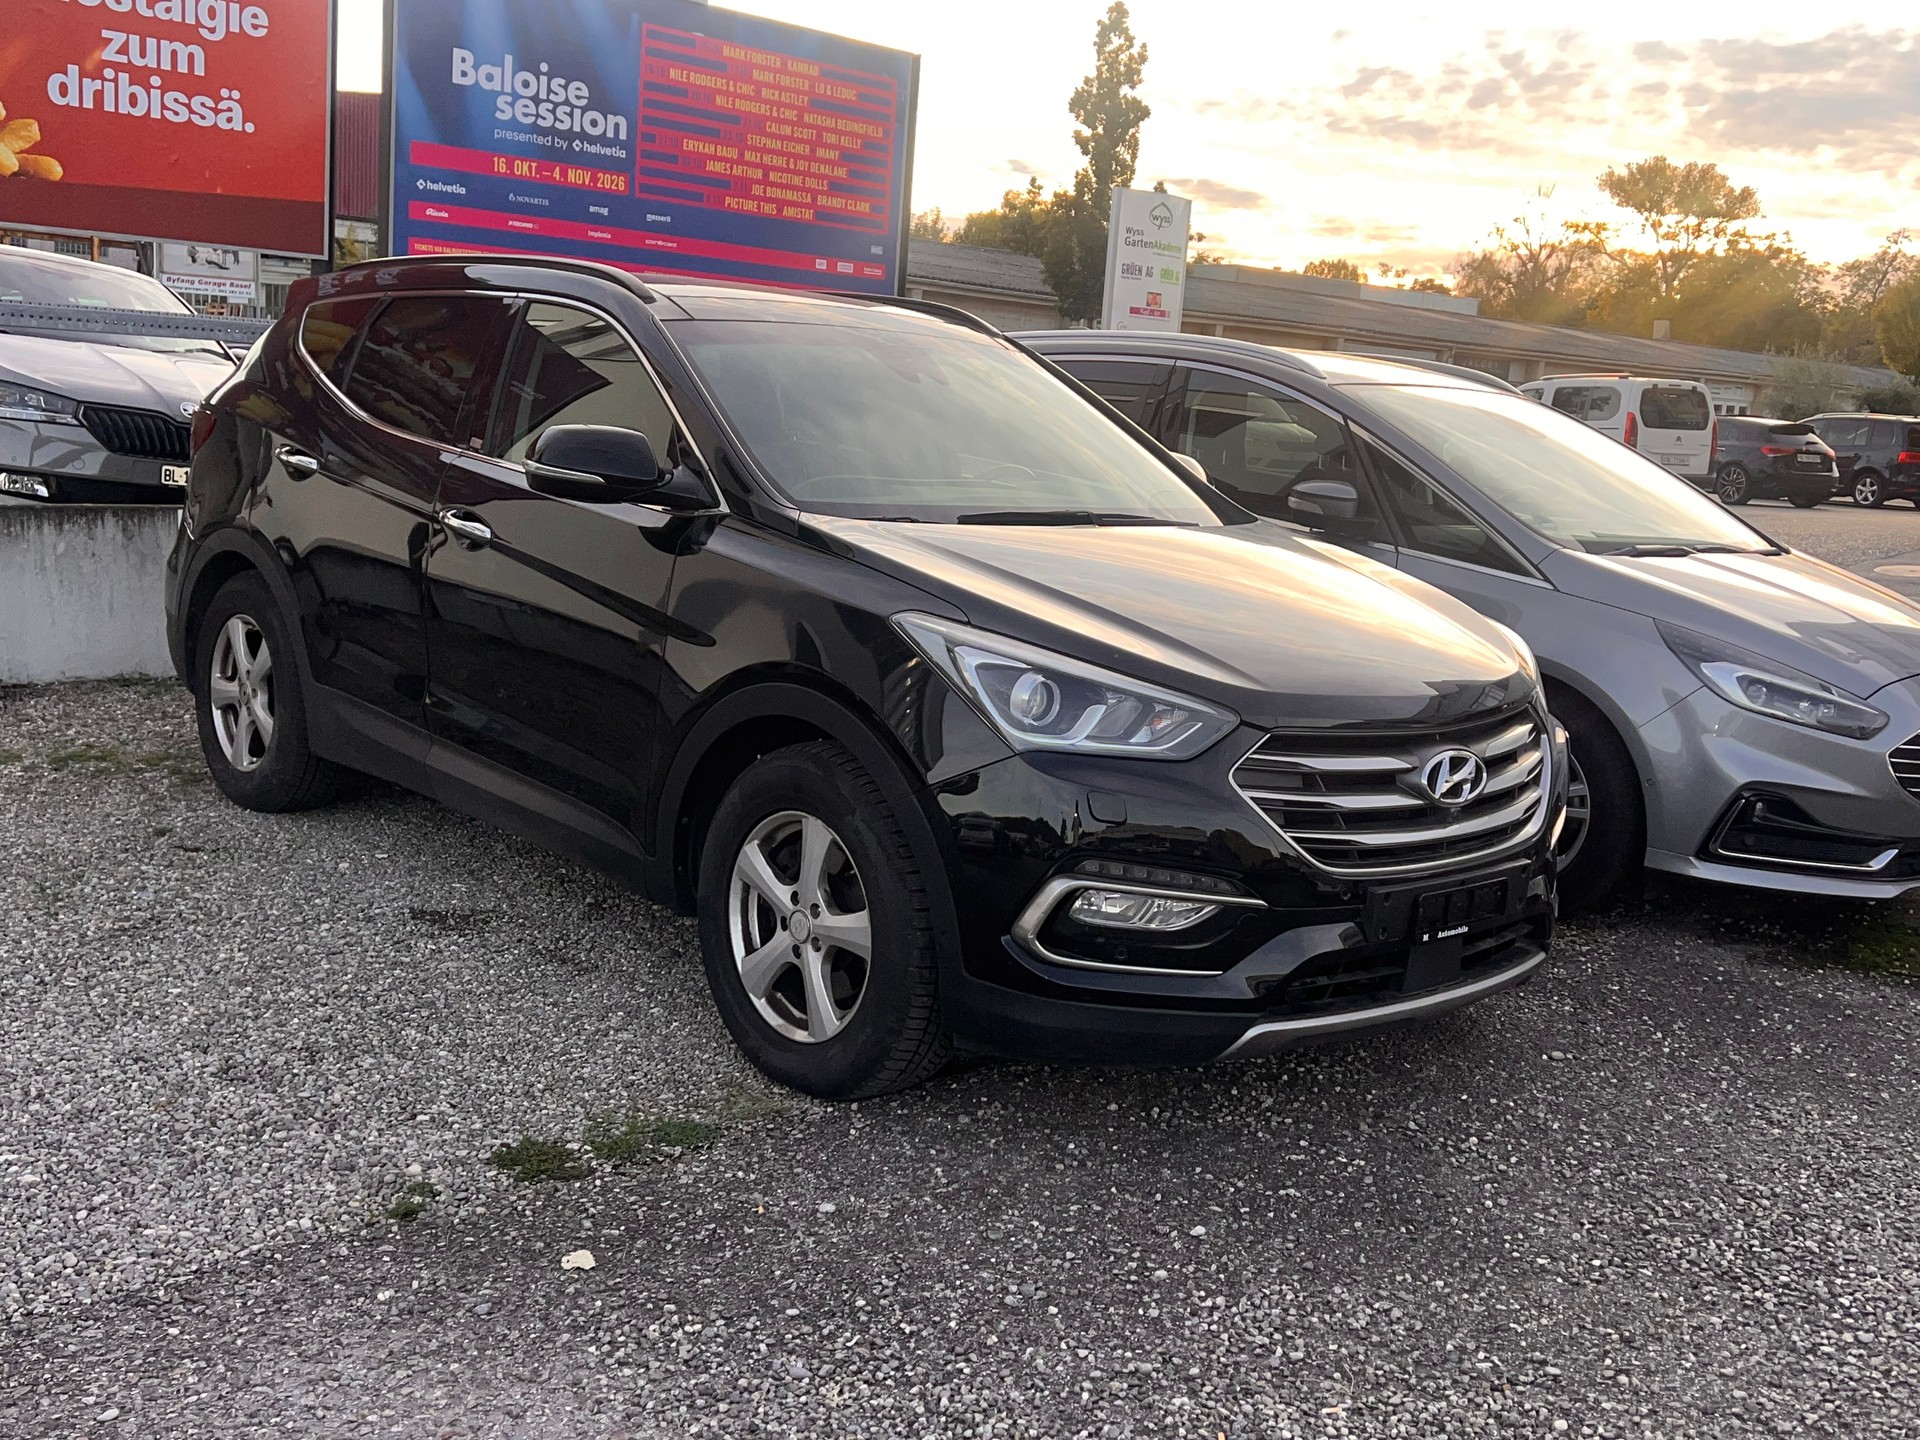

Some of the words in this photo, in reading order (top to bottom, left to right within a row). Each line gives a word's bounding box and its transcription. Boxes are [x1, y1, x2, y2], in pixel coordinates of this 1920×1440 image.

[59, 0, 269, 41] algie
[101, 29, 205, 76] zum
[723, 45, 746, 61] MARK
[747, 50, 781, 68] FORSTER
[787, 59, 819, 77] KAMRAD
[452, 47, 589, 106] Baloise
[669, 67, 688, 82] NILE
[690, 71, 727, 90] RODGERS
[728, 80, 734, 92] &
[736, 82, 755, 97] CHIC
[761, 87, 780, 102] RICK
[781, 91, 809, 107] ASTLEY
[753, 69, 774, 84] MARK
[775, 73, 809, 91] FORSTER
[815, 82, 825, 93] LO
[826, 84, 832, 95] &
[833, 85, 858, 101] LEDUC
[47, 64, 255, 134] dribissä.
[495, 94, 627, 140] session
[715, 94, 735, 109] NILE
[735, 98, 771, 116] RODGERS
[772, 105, 778, 118] &
[779, 107, 798, 121] CHIC
[803, 112, 836, 128] NATASHA
[837, 119, 883, 138] BEDINGFIELD
[494, 128, 552, 147] presented
[554, 135, 568, 150] by
[583, 141, 626, 158] helvetia
[747, 134, 782, 150] STEPHAN
[783, 140, 810, 155] EICHER
[816, 146, 840, 161] IMANY
[766, 121, 792, 134] CALUM
[793, 126, 817, 141] SCOTT
[823, 131, 839, 145] TORI
[841, 135, 862, 149] KELLY
[493, 156, 510, 174] 16.
[514, 159, 540, 178] OKT.
[568, 169, 594, 187] NOV.
[597, 172, 625, 191] 2026
[683, 138, 715, 155] ERYKAH
[716, 144, 738, 160] BADU
[744, 150, 761, 164] MAX
[762, 153, 787, 166] HERRE
[789, 157, 795, 170] &
[796, 159, 809, 173] JOY
[810, 161, 848, 179] DENALANE
[426, 180, 466, 195] helvetia
[705, 159, 731, 175] JAMES
[732, 163, 763, 180] ARTHUR
[769, 171, 804, 187] NICOTINE
[805, 176, 828, 191] DOLLS
[516, 194, 549, 206] NOVARTIS
[589, 204, 609, 216] amag
[725, 196, 759, 212] PICTURE
[759, 201, 777, 215] THIS
[782, 205, 814, 220] AMISTAT
[751, 183, 765, 197] JOE
[766, 186, 812, 204] BONAMASSA
[817, 194, 846, 210] BRANDY
[847, 199, 870, 213] CLARK
[1125, 225, 1145, 237] Wyss
[166, 276, 195, 286] Byfang
[197, 279, 227, 288] Garage
[1121, 262, 1143, 277] GRÜEN
[1145, 265, 1154, 278] AG
[164, 468, 179, 483] BL
[1437, 925, 1469, 939] Automobile
